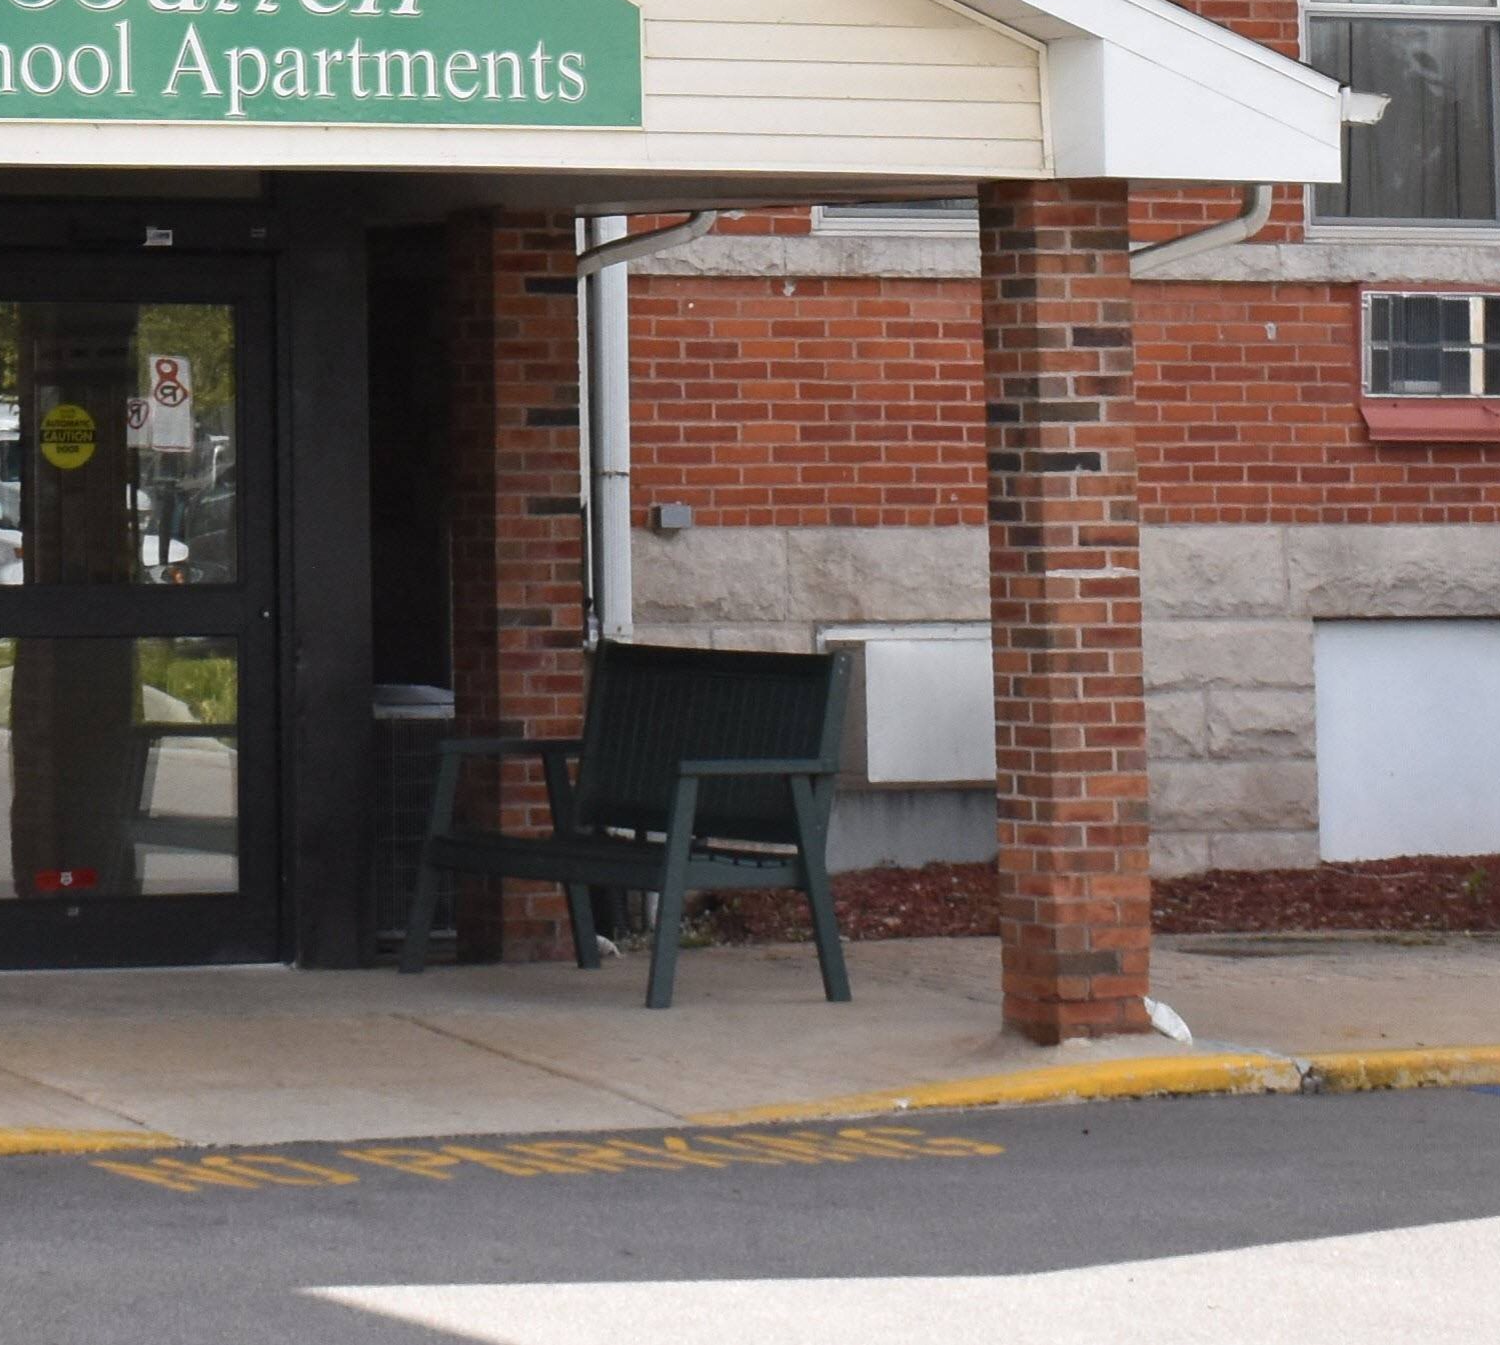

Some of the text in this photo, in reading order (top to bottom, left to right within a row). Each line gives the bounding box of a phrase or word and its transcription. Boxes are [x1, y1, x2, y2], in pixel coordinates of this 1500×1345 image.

[162, 21, 587, 118] Apartments
[42, 430, 94, 443] CAUTION
[86, 1126, 1006, 1193] NO PARKING
